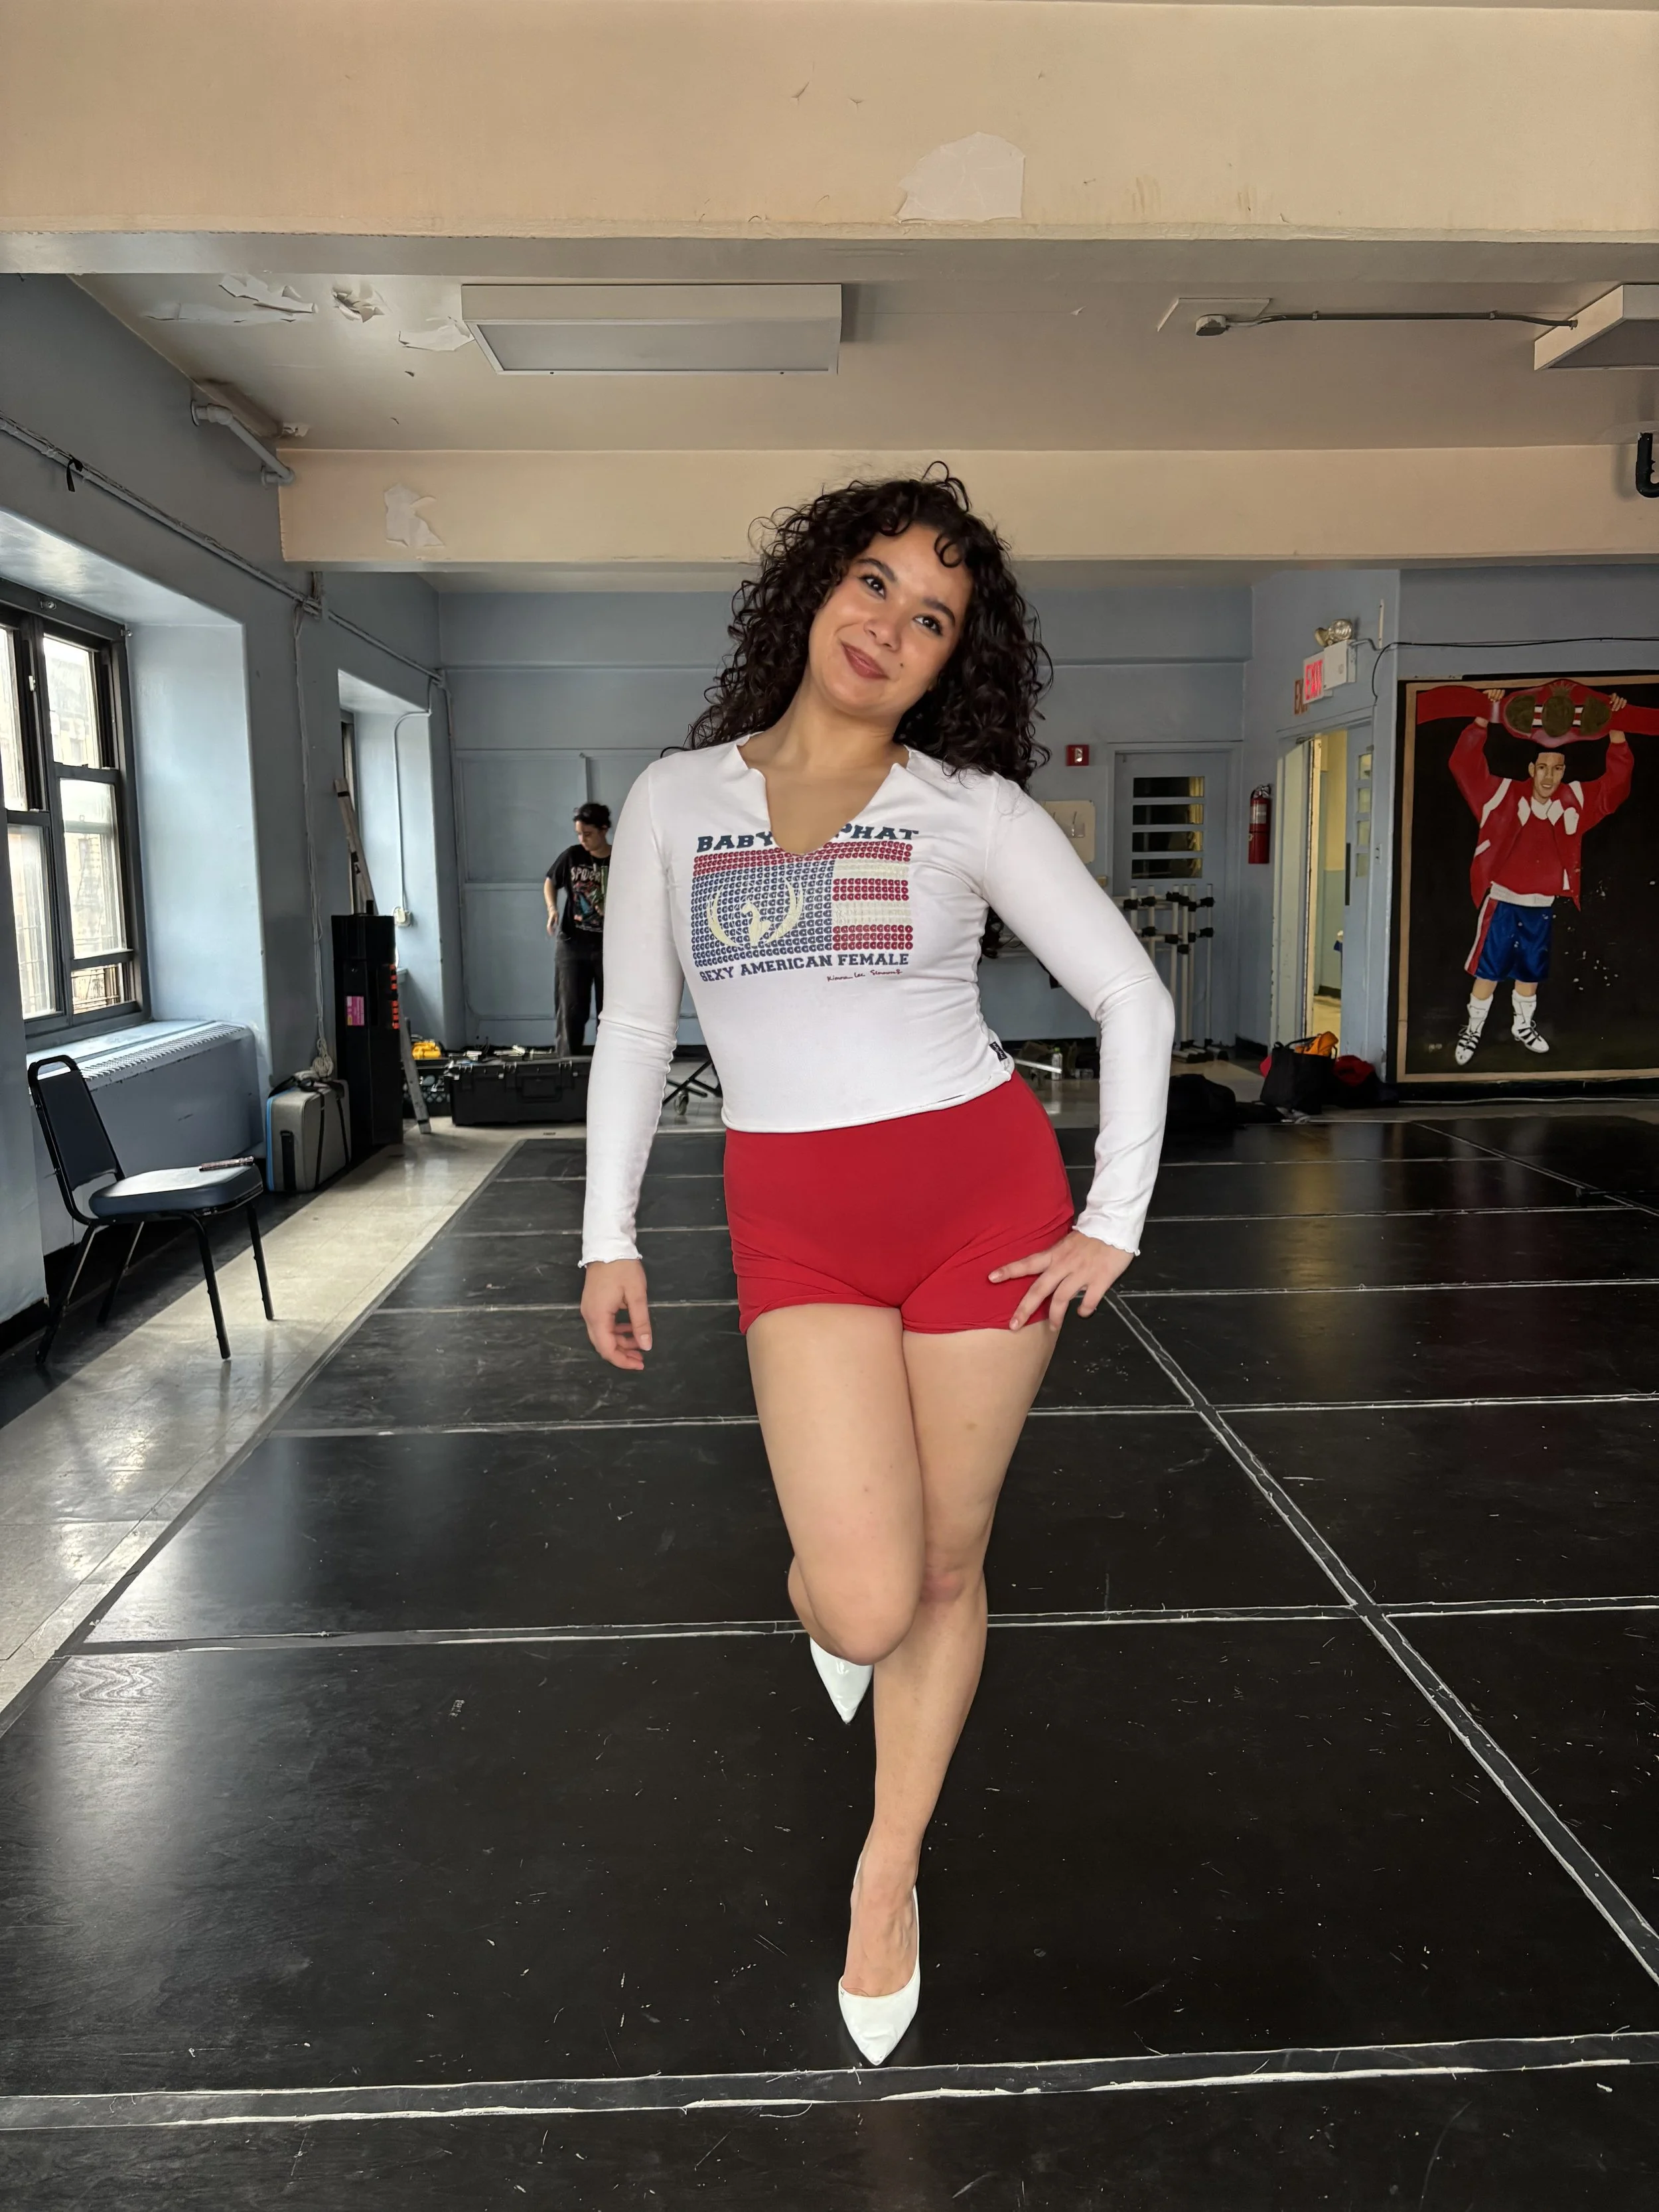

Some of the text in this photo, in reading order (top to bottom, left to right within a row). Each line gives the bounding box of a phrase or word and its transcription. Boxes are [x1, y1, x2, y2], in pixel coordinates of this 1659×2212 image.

[1305, 660, 1323, 700] EXIT
[697, 831, 773, 853] BABY
[699, 953, 909, 982] SEXY AMERICAN FEMALE
